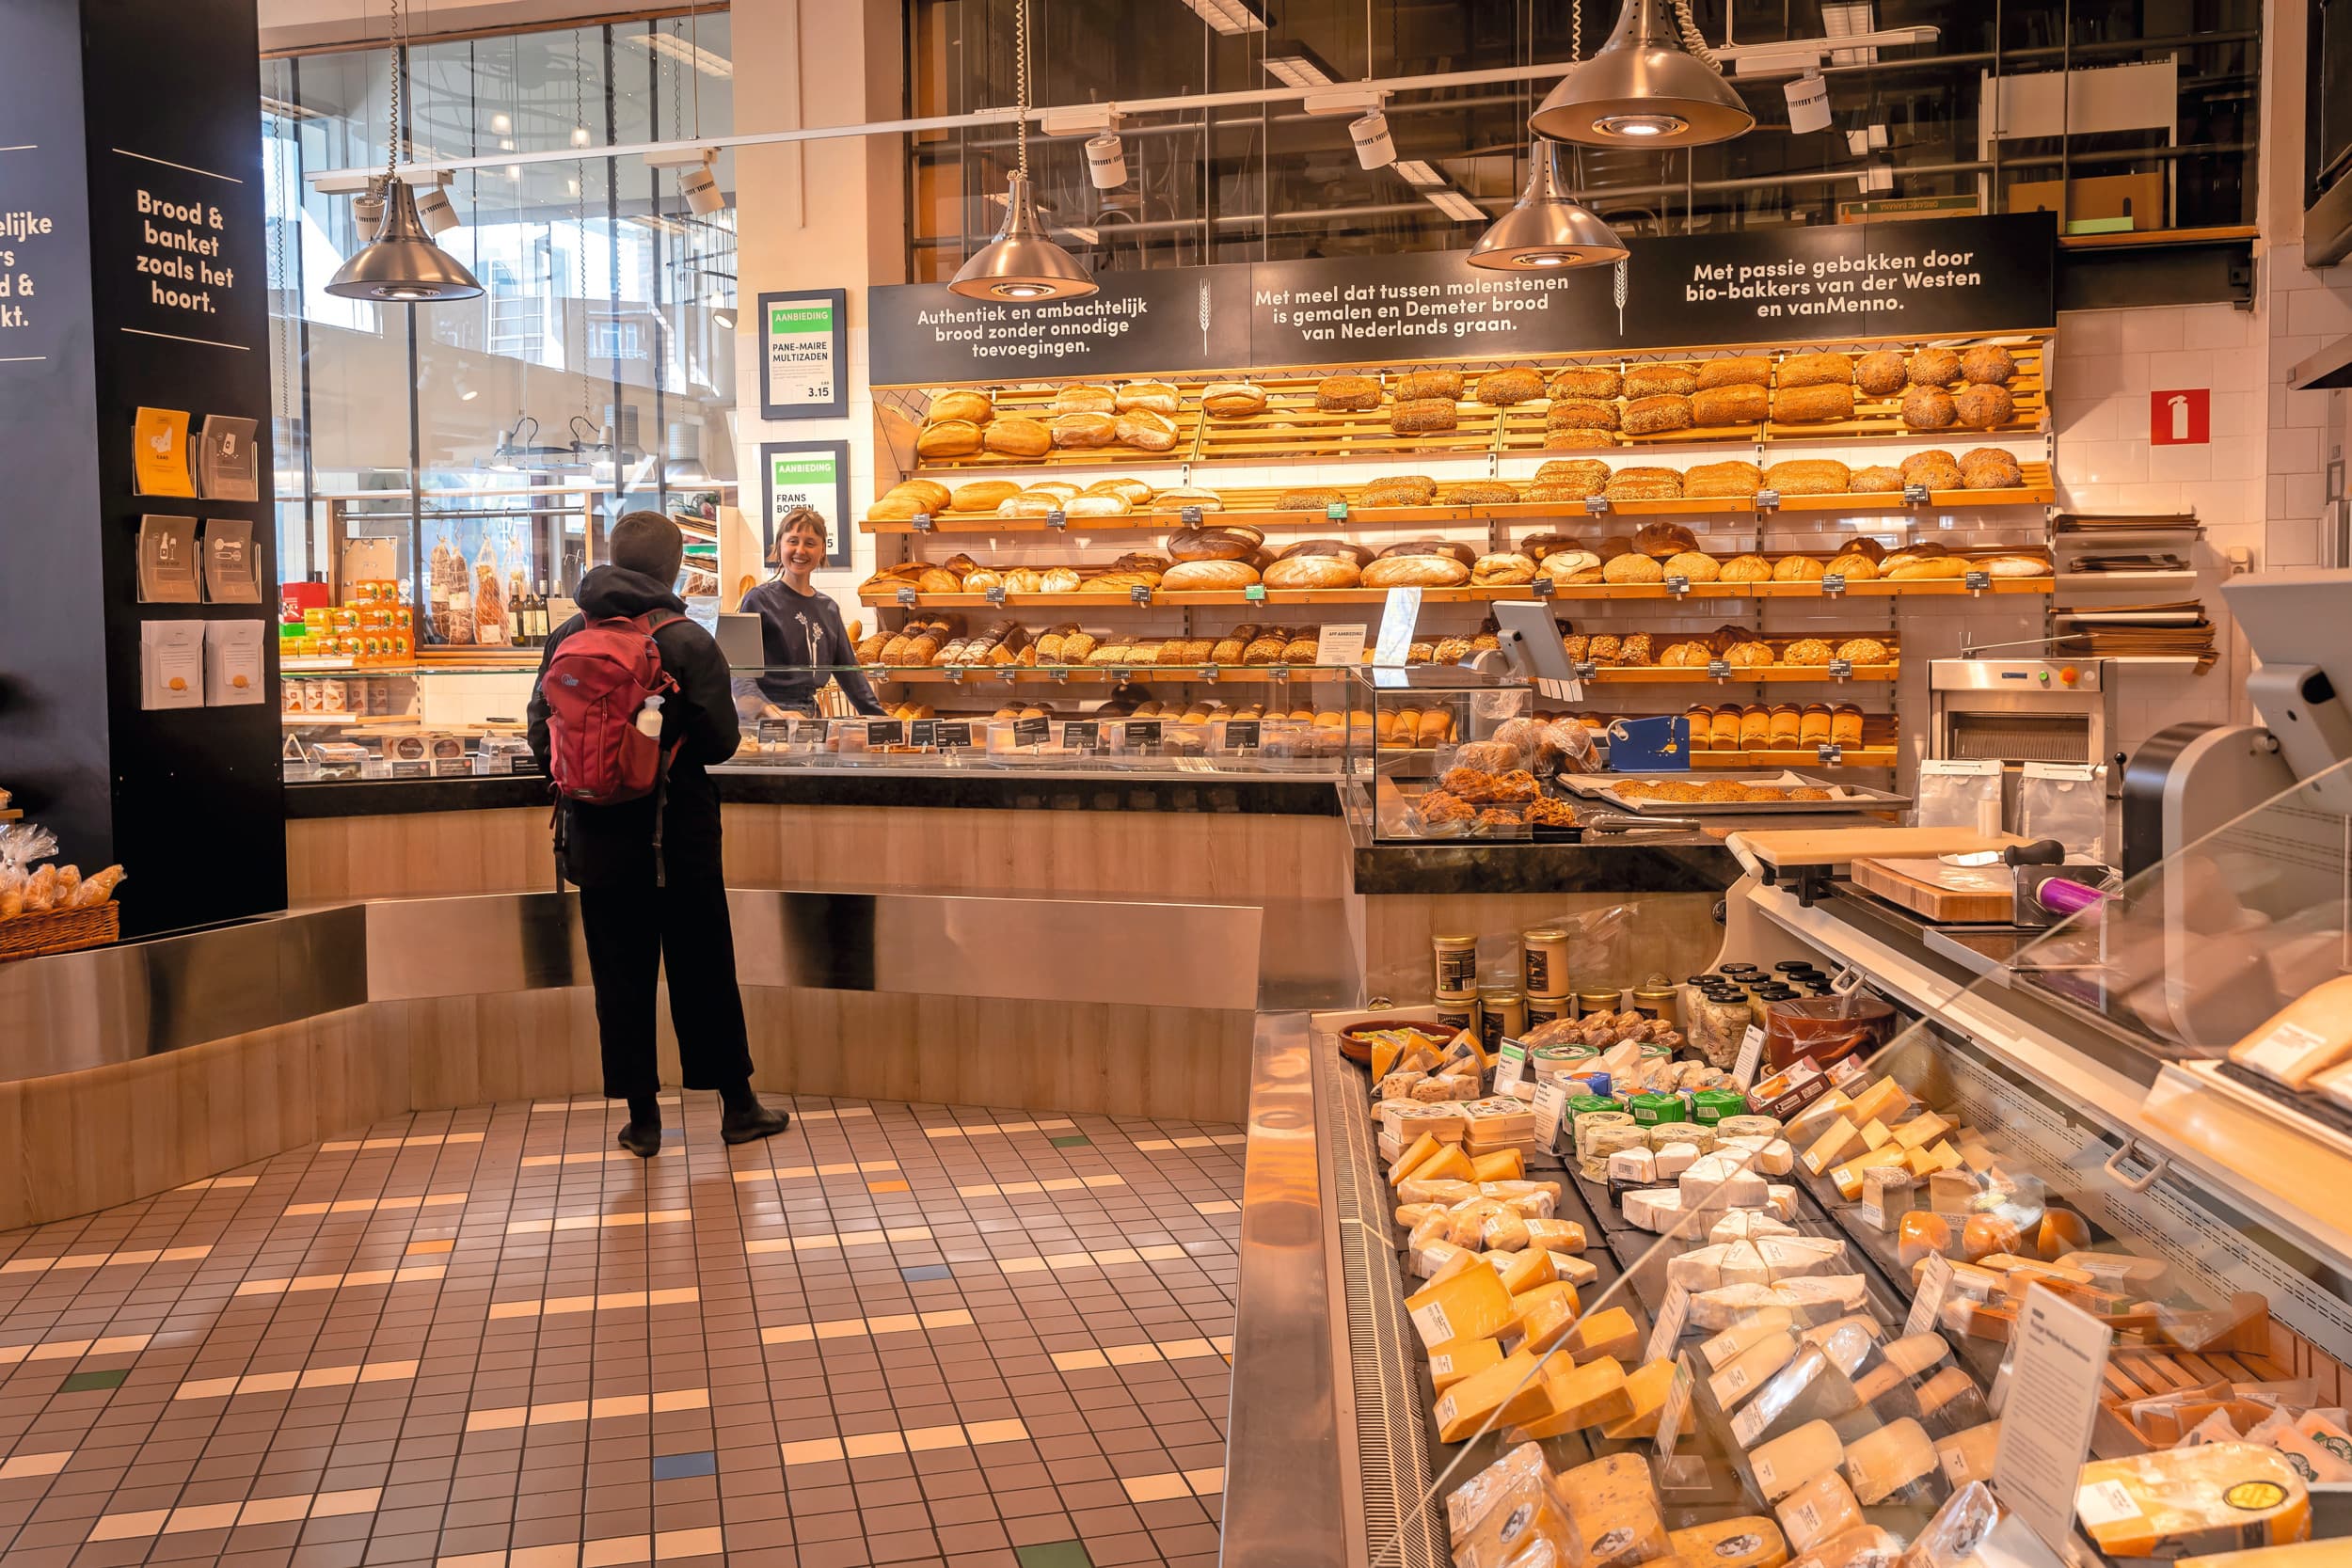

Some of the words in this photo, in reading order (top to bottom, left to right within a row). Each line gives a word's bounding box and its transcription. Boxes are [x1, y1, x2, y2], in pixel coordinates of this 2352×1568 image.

[137, 189, 202, 225] Brood
[209, 206, 224, 230] &
[144, 220, 219, 257] banket
[136, 255, 195, 280] zoals
[200, 261, 234, 288] het
[1693, 262, 1733, 281] Met
[1740, 259, 1805, 283] passie
[1812, 253, 1916, 278] gebakken
[1922, 249, 1974, 268] door
[18, 273, 35, 296] &
[1255, 289, 1290, 307] Met
[1295, 286, 1338, 305] meel
[1344, 284, 1375, 302] dat
[1380, 283, 1440, 299] tussen
[1447, 277, 1569, 295] molenstenen
[1686, 279, 1811, 302] bio-bakkers
[1816, 277, 1854, 293] van
[1861, 274, 1898, 292] der
[1902, 270, 1981, 290] Westen
[151, 280, 216, 314] hoort.
[1756, 303, 1782, 317] en
[1788, 296, 1904, 316] vanMenno.
[1, 304, 29, 327] kt.
[775, 311, 829, 322] AANBIEDING
[917, 306, 1007, 325] Authentiek
[1011, 307, 1031, 321] en
[1036, 297, 1149, 319] ambachtelijk
[1272, 309, 1288, 325] is
[1293, 305, 1372, 326] gemalen
[1377, 306, 1400, 319] en
[1406, 297, 1486, 318] Demeter
[1492, 293, 1549, 312] brood
[935, 325, 983, 342] brood
[988, 322, 1046, 340] zonder
[1050, 318, 1130, 338] onnodige
[1302, 326, 1335, 341] van
[1342, 318, 1448, 339] Nederlands
[1454, 318, 1518, 338] graan.
[772, 341, 827, 352] PANE-MAIRE
[772, 352, 828, 362] MULTIZADEN
[972, 340, 1090, 359] toevoegingen.
[808, 387, 829, 397] 3.15
[779, 464, 832, 473] AANBIEDING
[776, 494, 806, 503] FRANS
